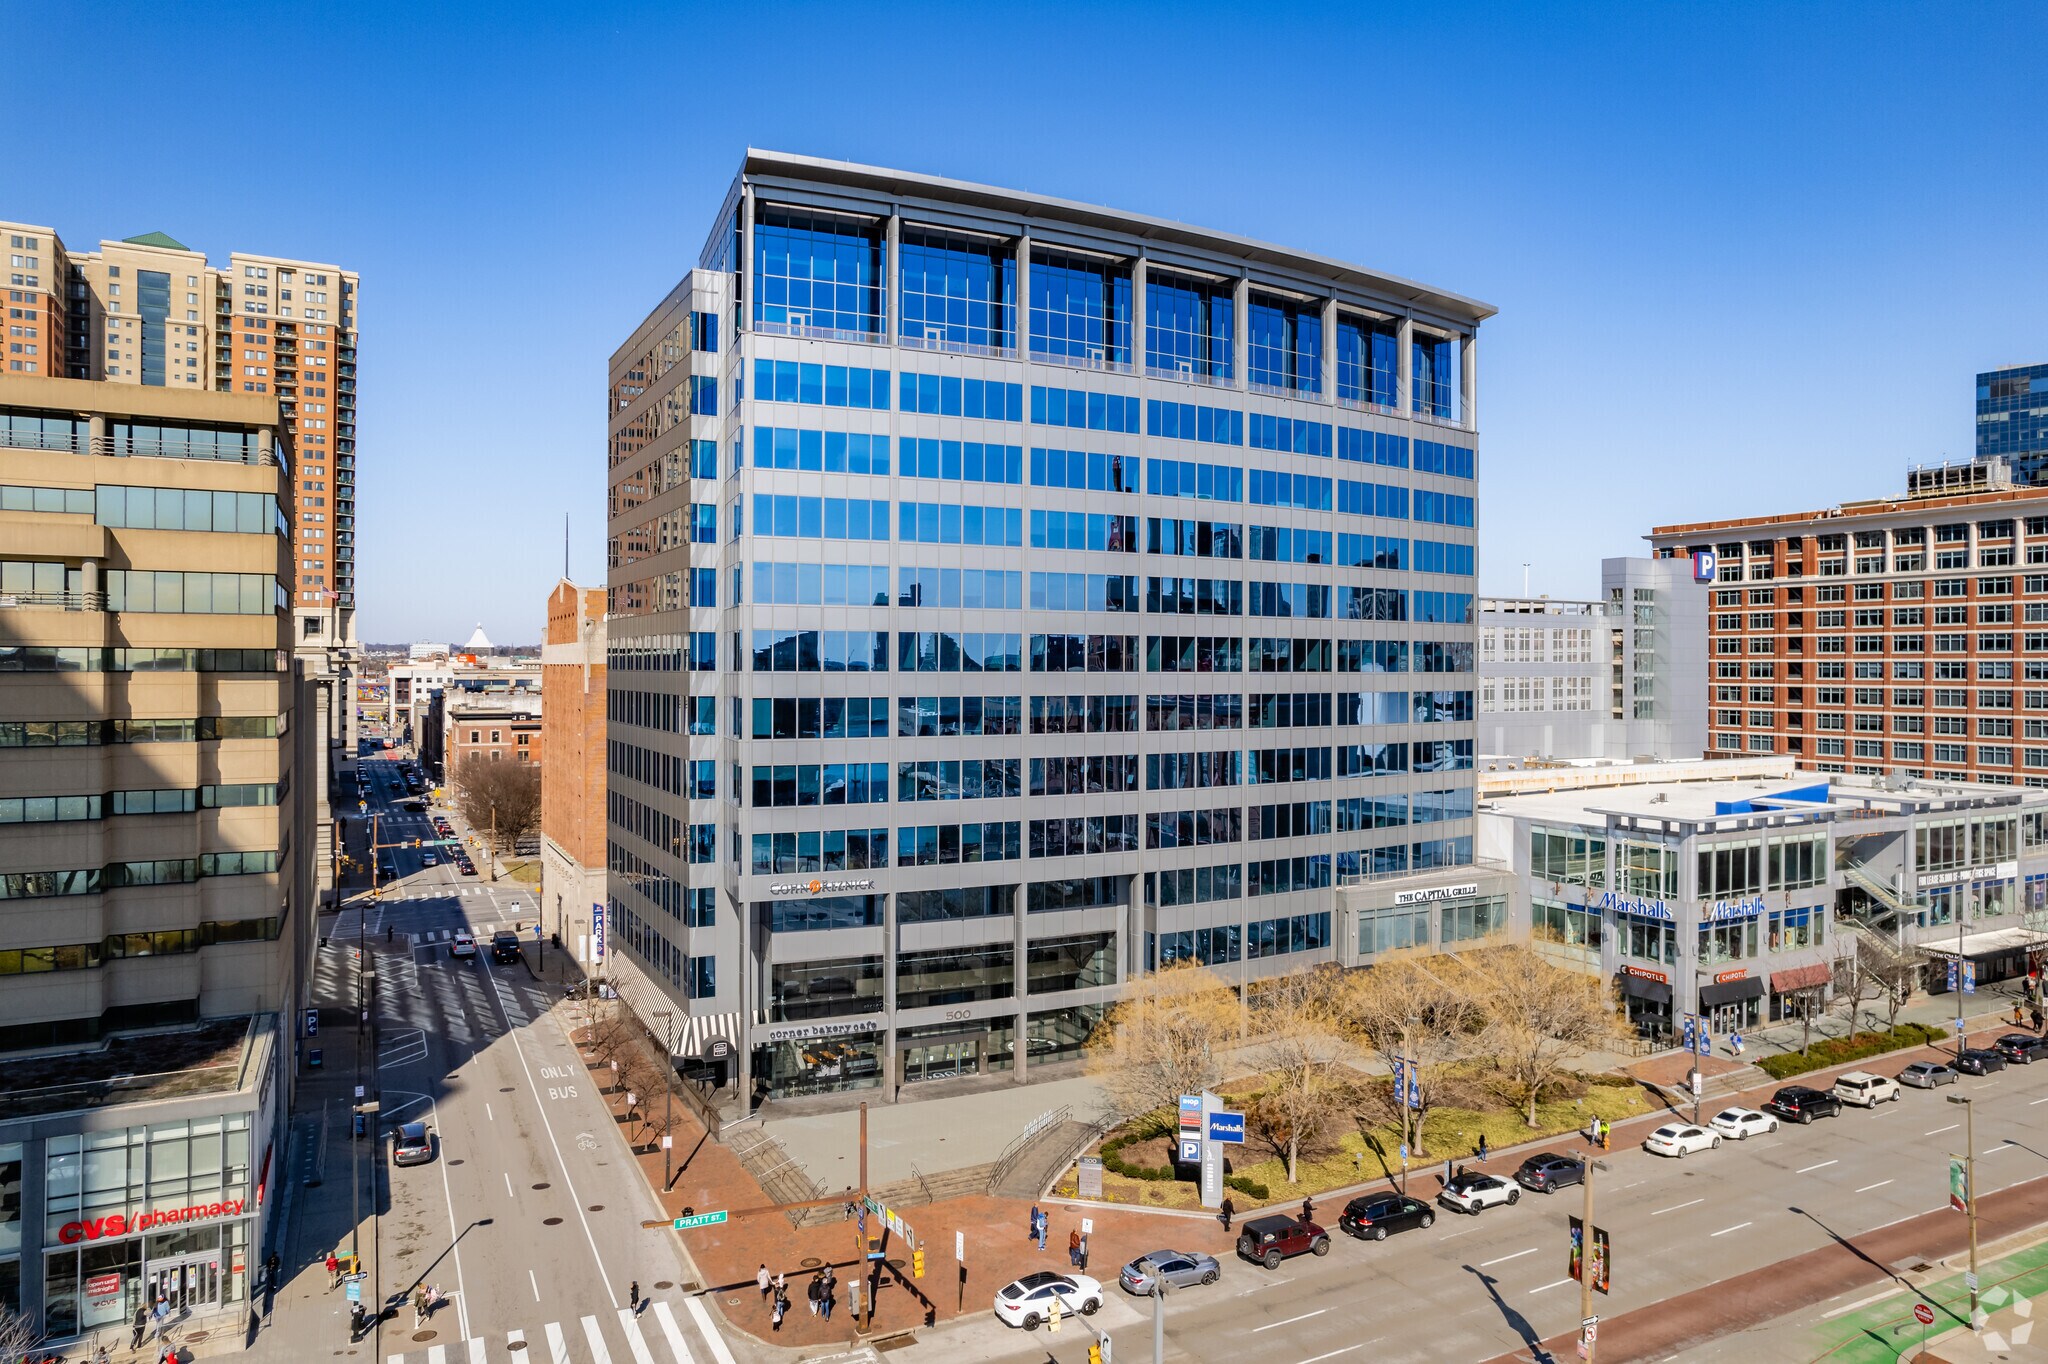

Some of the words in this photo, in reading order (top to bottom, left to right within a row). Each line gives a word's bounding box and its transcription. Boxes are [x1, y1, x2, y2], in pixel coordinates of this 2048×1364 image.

[1702, 555, 1713, 576] P
[1398, 893, 1413, 903] THE
[1414, 888, 1452, 902] CAPITAL
[1453, 886, 1477, 896] GRILLE
[1599, 892, 1672, 919] Marshalls
[1710, 896, 1766, 921] Marshalls
[595, 915, 603, 944] PARK
[1630, 968, 1664, 982] CHIPOTLE
[308, 1016, 316, 1026] P
[946, 1009, 971, 1021] 500
[769, 1028, 809, 1041] corner
[811, 1023, 852, 1035] bakery
[853, 1020, 877, 1031] cafe
[540, 1064, 575, 1079] ONLY
[548, 1085, 578, 1100] BUS
[1210, 1122, 1244, 1133] Marshalls
[1183, 1142, 1197, 1158] P
[679, 1215, 710, 1228] PRATT
[88, 1280, 104, 1288] open
[104, 1277, 118, 1285] until
[88, 1284, 115, 1294] midnight
